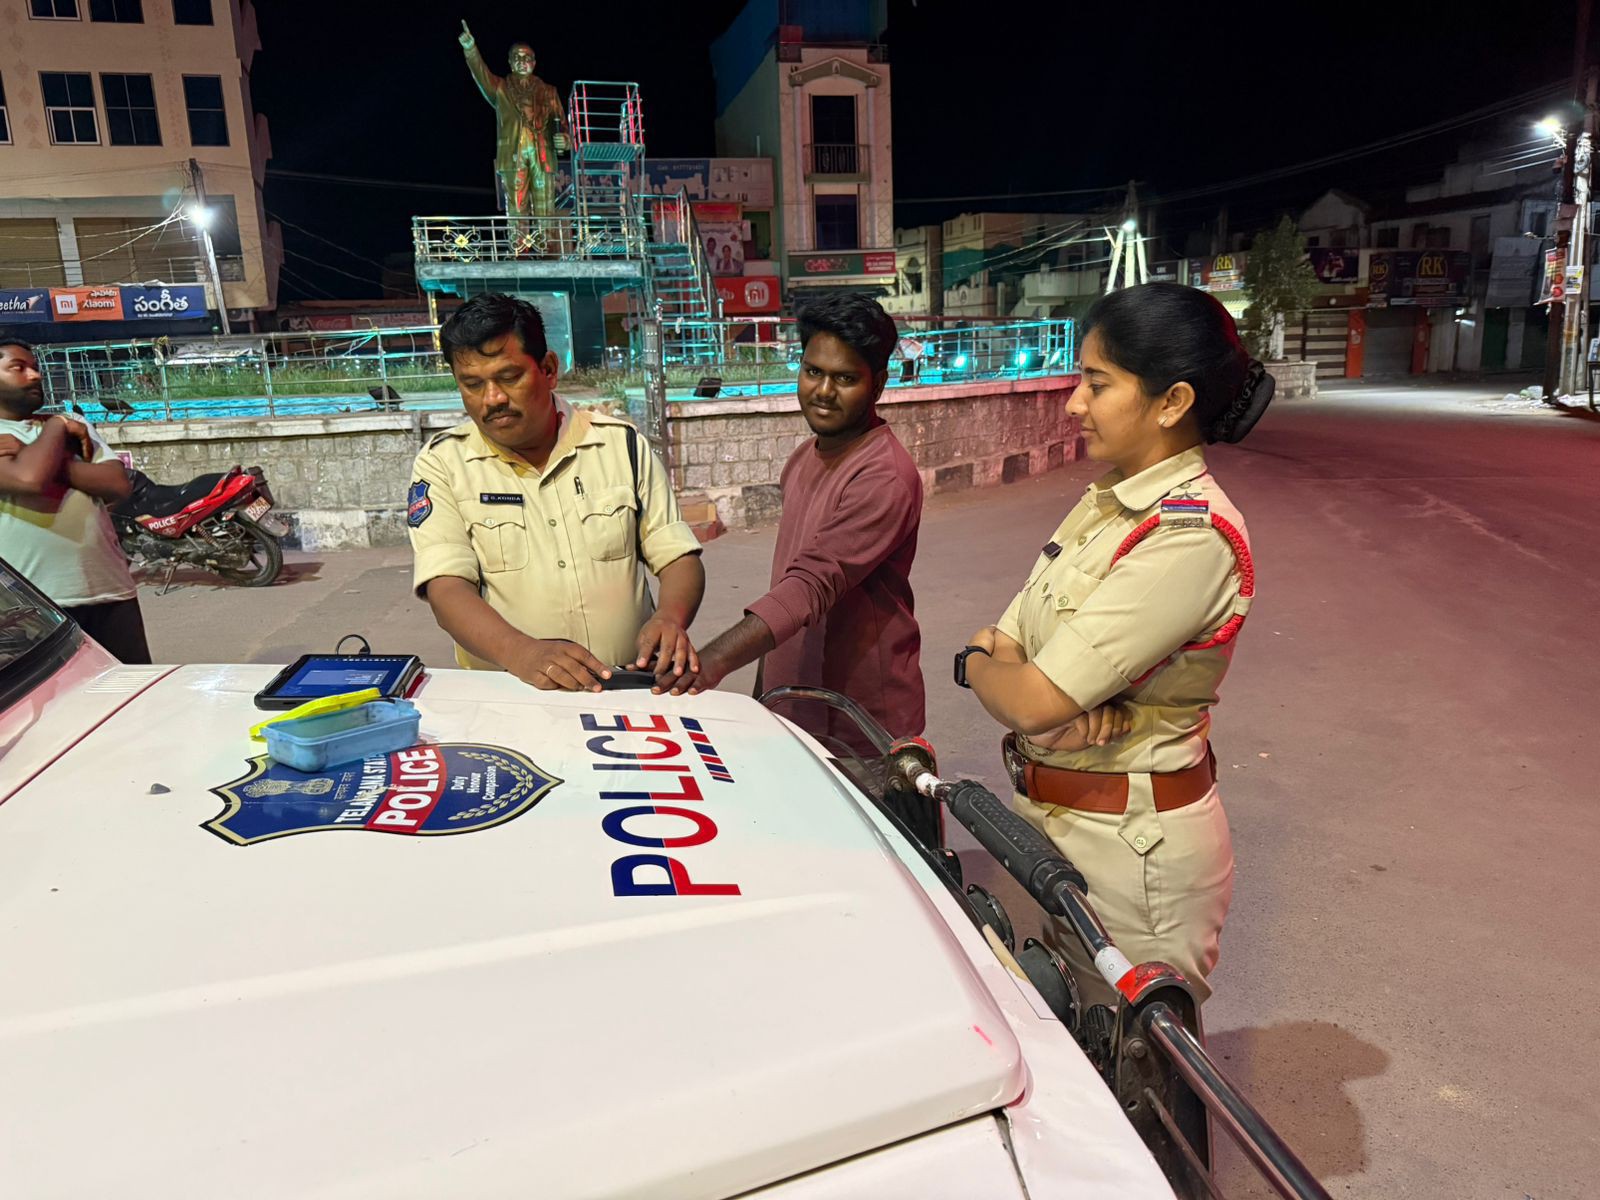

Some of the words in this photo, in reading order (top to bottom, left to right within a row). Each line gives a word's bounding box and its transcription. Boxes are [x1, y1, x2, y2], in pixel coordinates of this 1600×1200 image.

[1216, 255, 1233, 271] RK
[1421, 256, 1445, 275] RK
[134, 289, 189, 312] సంగీత
[148, 516, 177, 530] POLICE
[373, 748, 440, 827] POLICE
[451, 775, 468, 791] Duty
[467, 772, 482, 794] Honour
[482, 765, 499, 801] Compassion
[580, 713, 742, 897] POLICE
